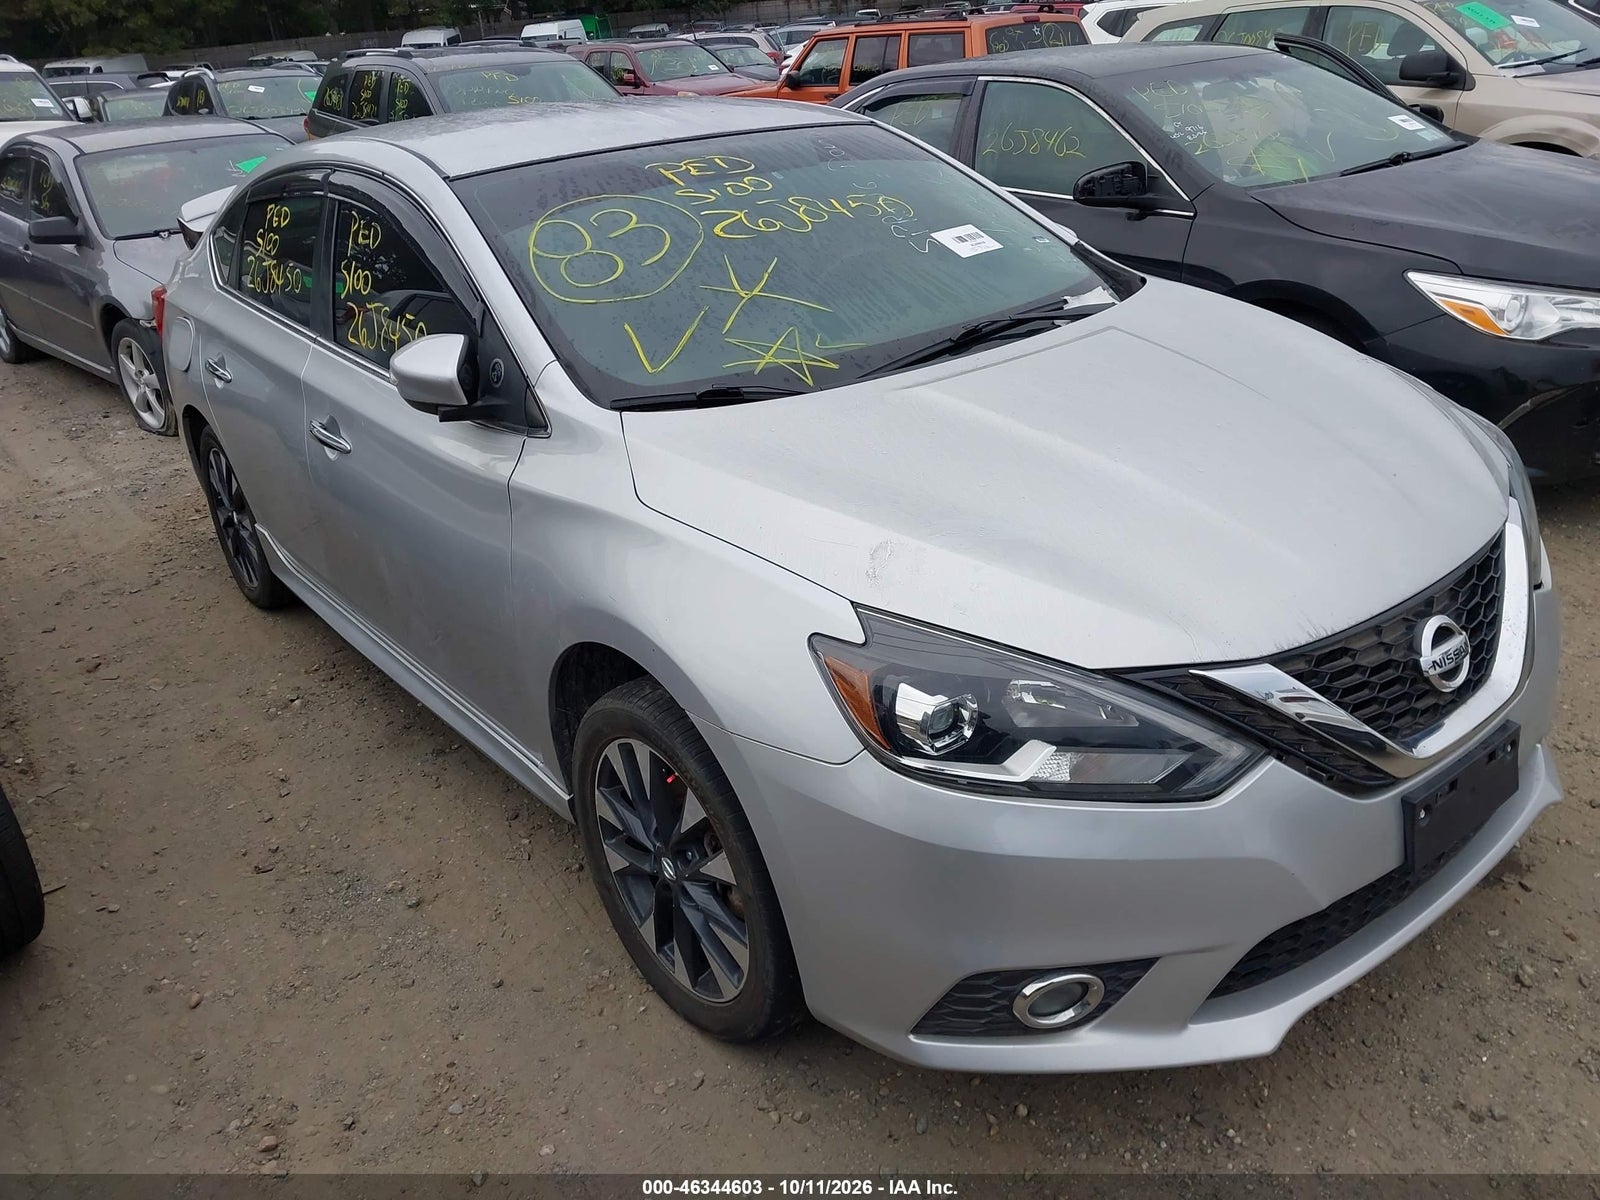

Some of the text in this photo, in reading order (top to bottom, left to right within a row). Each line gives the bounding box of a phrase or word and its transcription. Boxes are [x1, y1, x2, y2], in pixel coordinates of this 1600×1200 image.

[982, 121, 1086, 158] 26J8462
[645, 155, 755, 187] PED
[674, 176, 773, 205] S100
[265, 203, 291, 230] PED
[256, 228, 281, 258] S100
[347, 211, 382, 257] PED
[246, 255, 303, 297] 26J8450
[341, 260, 373, 300] S100
[1428, 641, 1470, 672] NISSAN
